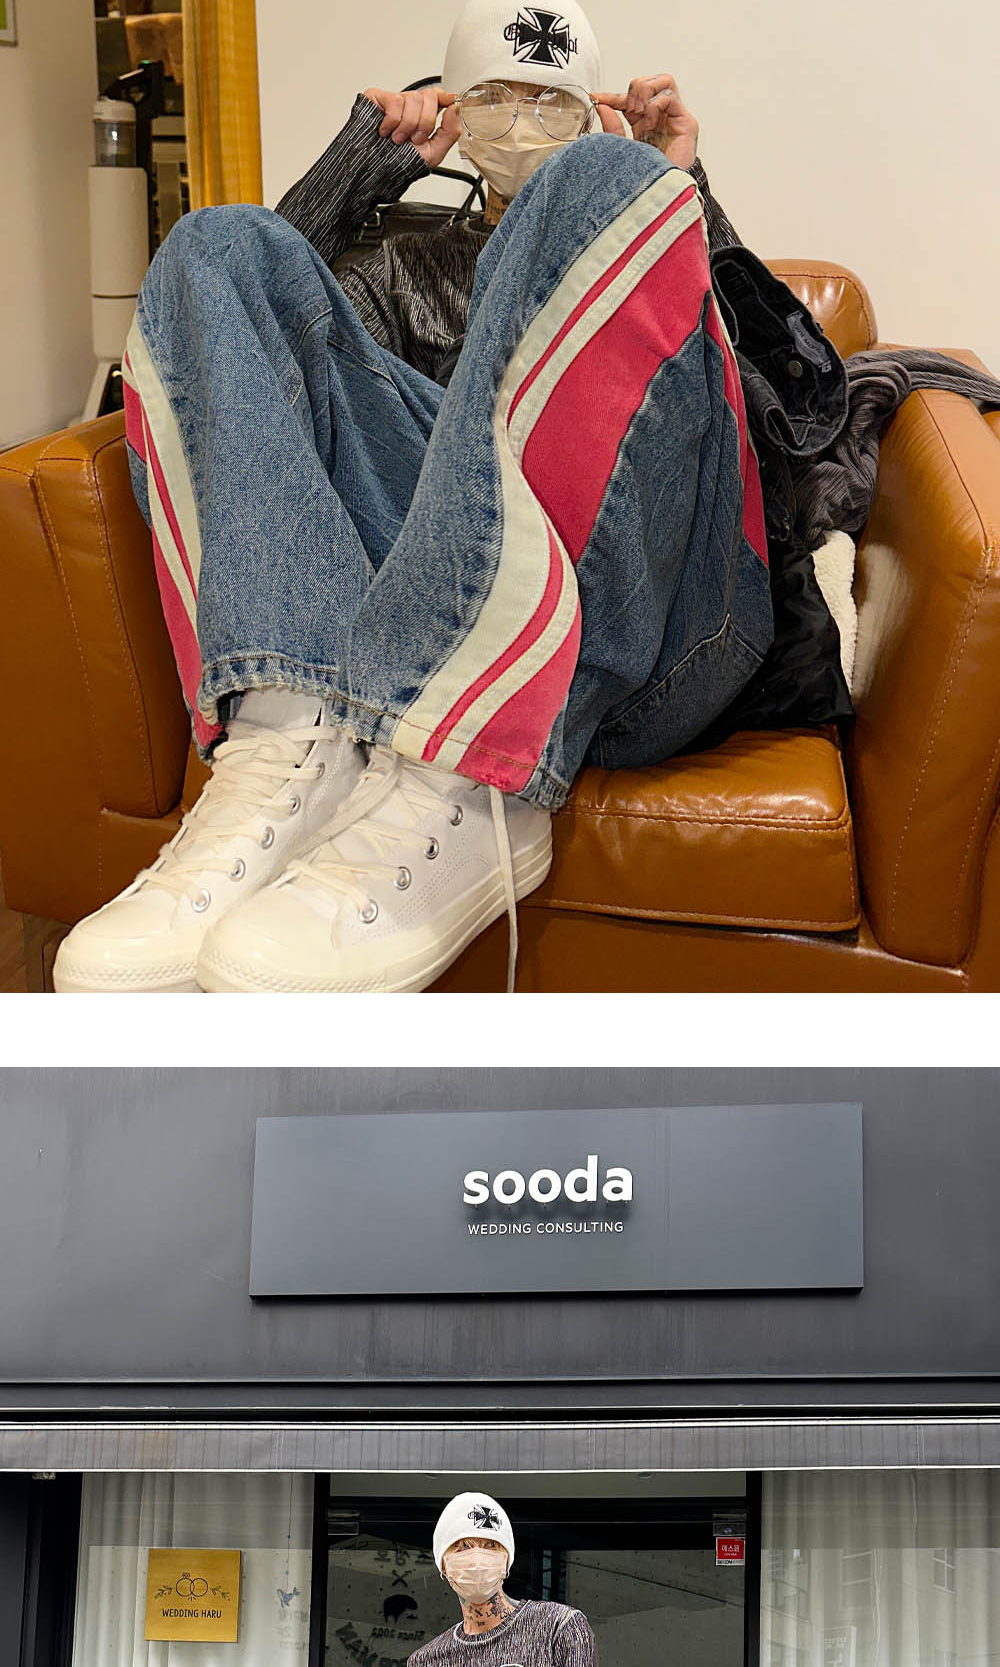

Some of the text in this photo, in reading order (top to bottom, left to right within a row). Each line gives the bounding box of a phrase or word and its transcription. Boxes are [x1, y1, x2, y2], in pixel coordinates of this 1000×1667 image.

[463, 1154, 633, 1205] sooda
[468, 1221, 624, 1235] WEDDING CONSULTING
[162, 1608, 222, 1619] WEDDING HARU
